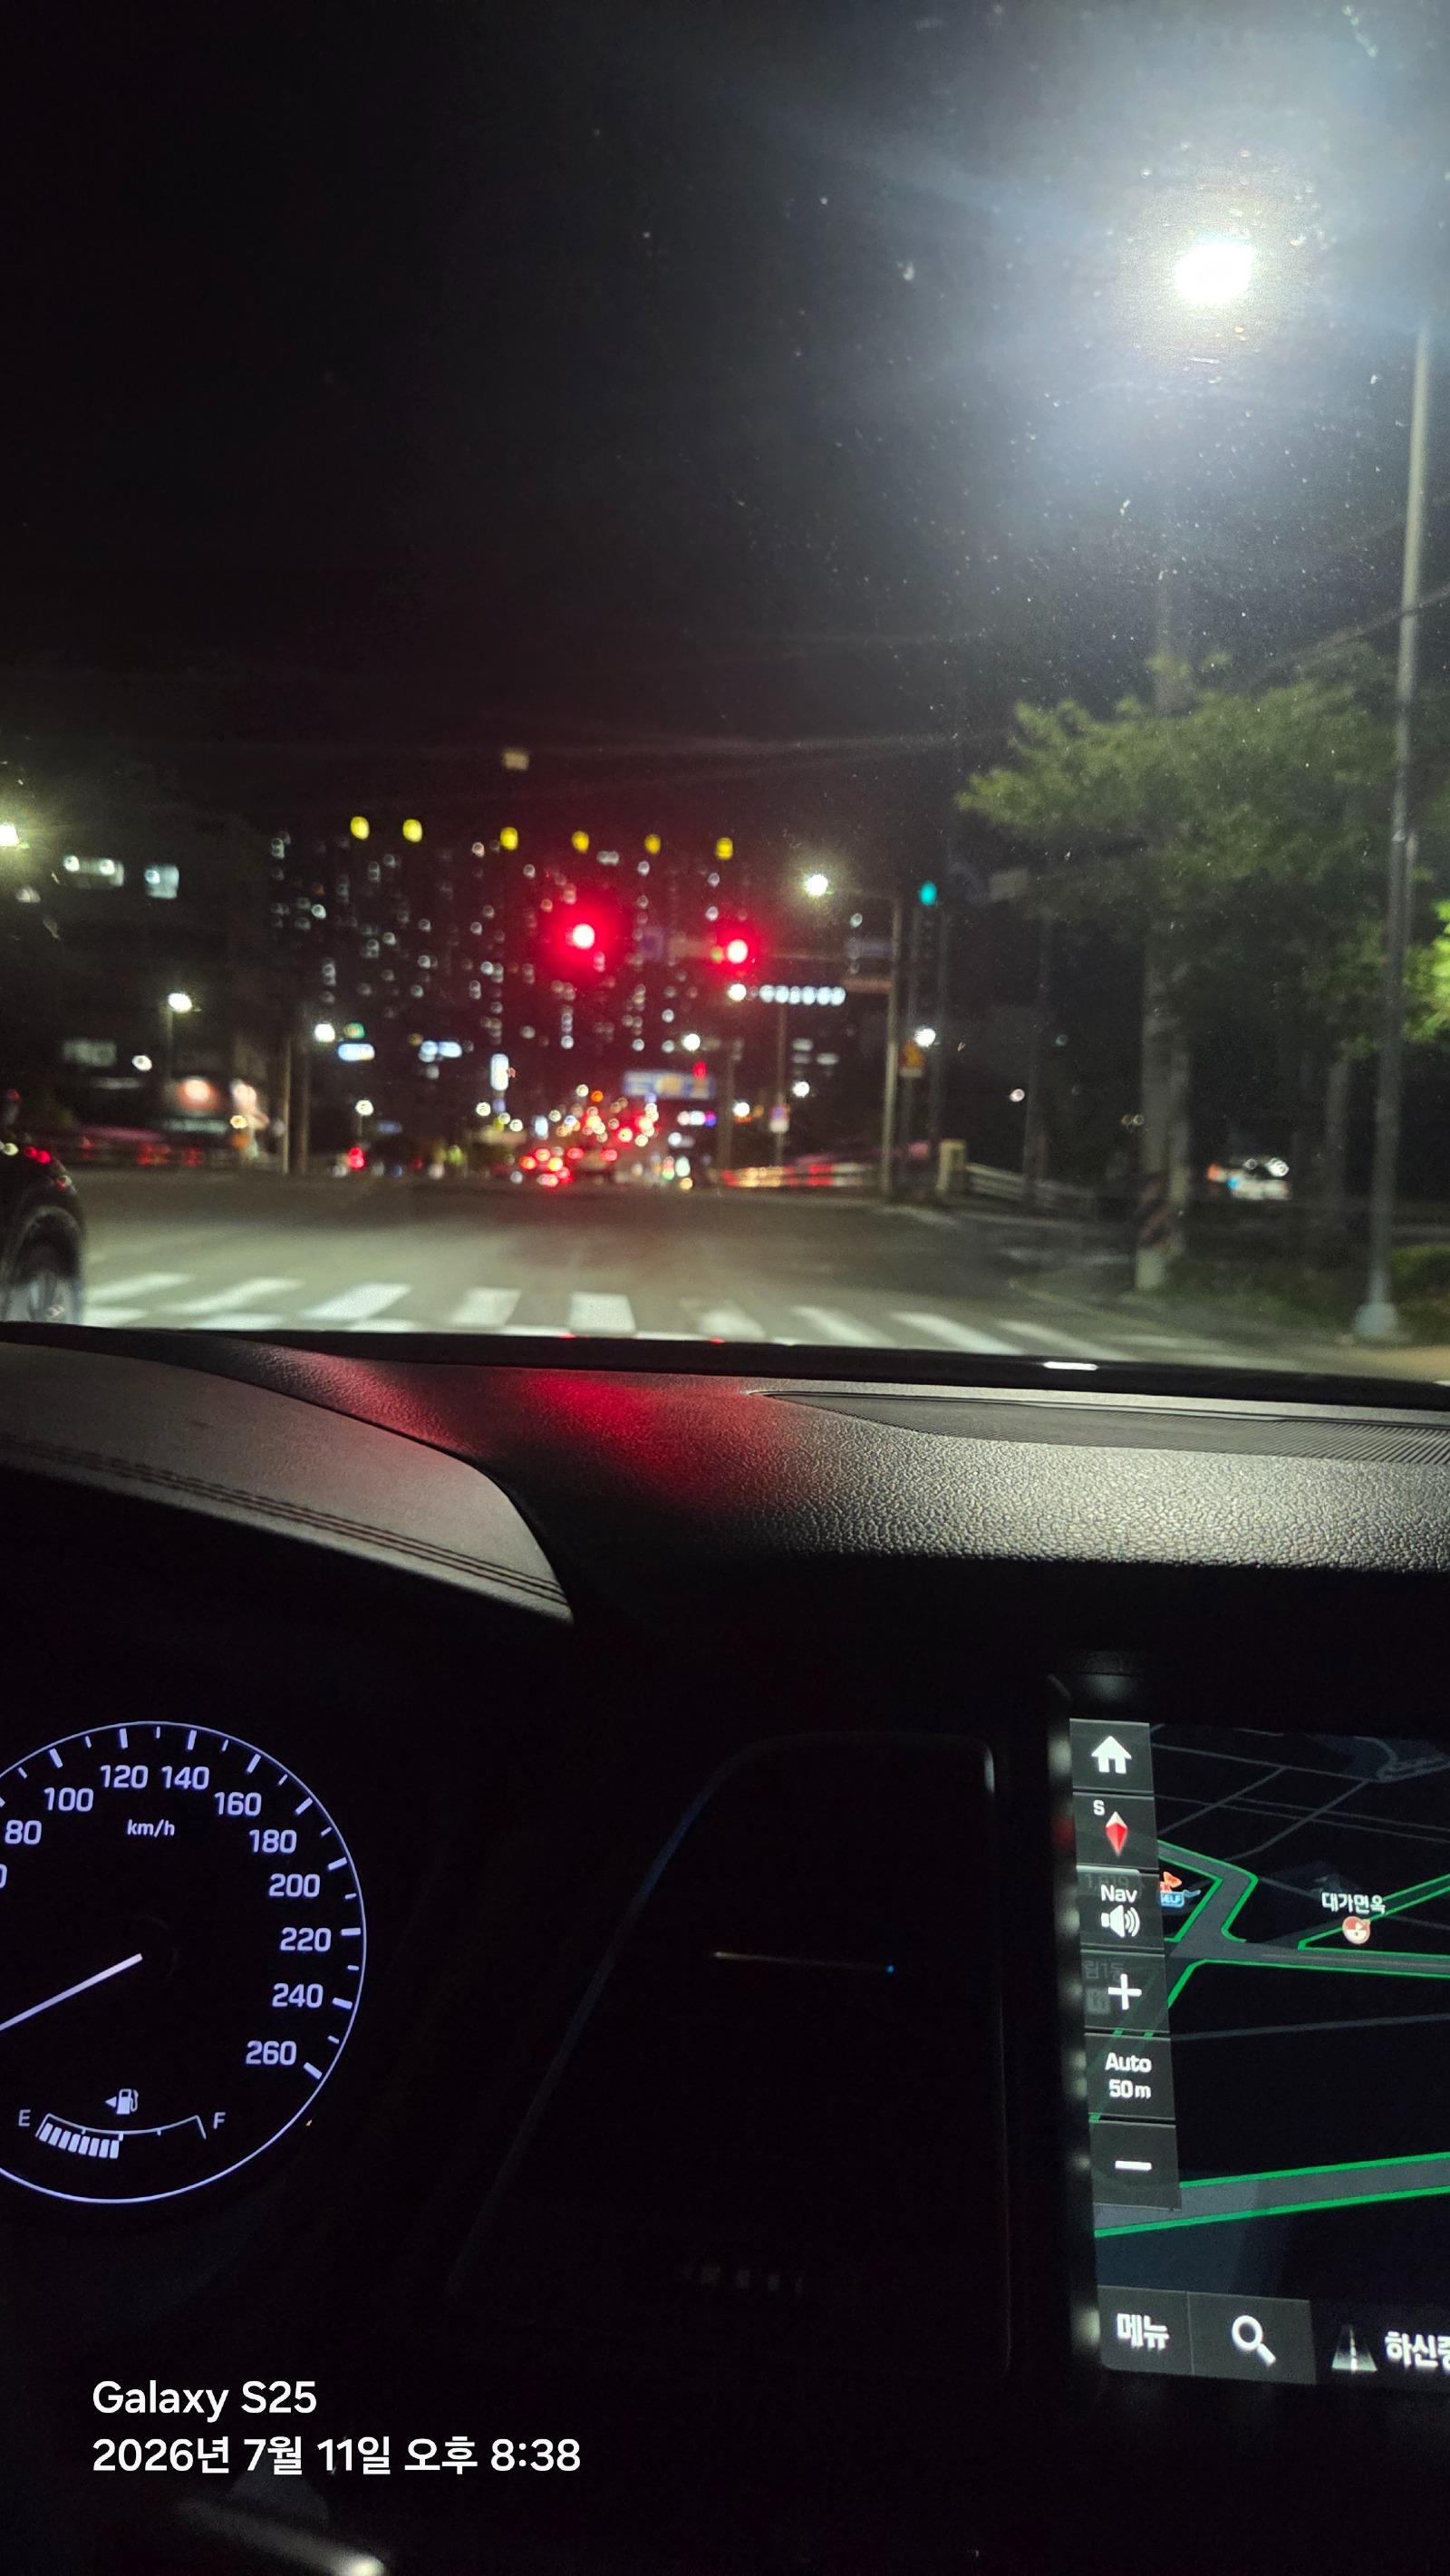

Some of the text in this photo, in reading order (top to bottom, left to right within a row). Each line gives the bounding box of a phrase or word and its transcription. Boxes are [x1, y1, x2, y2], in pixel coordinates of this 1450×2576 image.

[100, 1764, 149, 1790] 120
[161, 1764, 210, 1791] 140
[44, 1787, 94, 1813] 100
[214, 1791, 263, 1817] 160
[1092, 1799, 1106, 1816] S
[5, 1819, 43, 1845] 80
[127, 1818, 176, 1838] km/h
[249, 1828, 297, 1854] 180
[268, 1873, 321, 1898] 200
[1099, 1884, 1138, 1904] Nav
[1321, 1892, 1387, 1915] 대가면옥
[280, 1926, 332, 1952] 220
[272, 1982, 324, 2009] 240
[246, 2040, 297, 2066] 260
[1105, 2051, 1153, 2074] Auto
[18, 2109, 31, 2127] E
[213, 2112, 226, 2130] F
[1116, 2312, 1171, 2350] 메뉴
